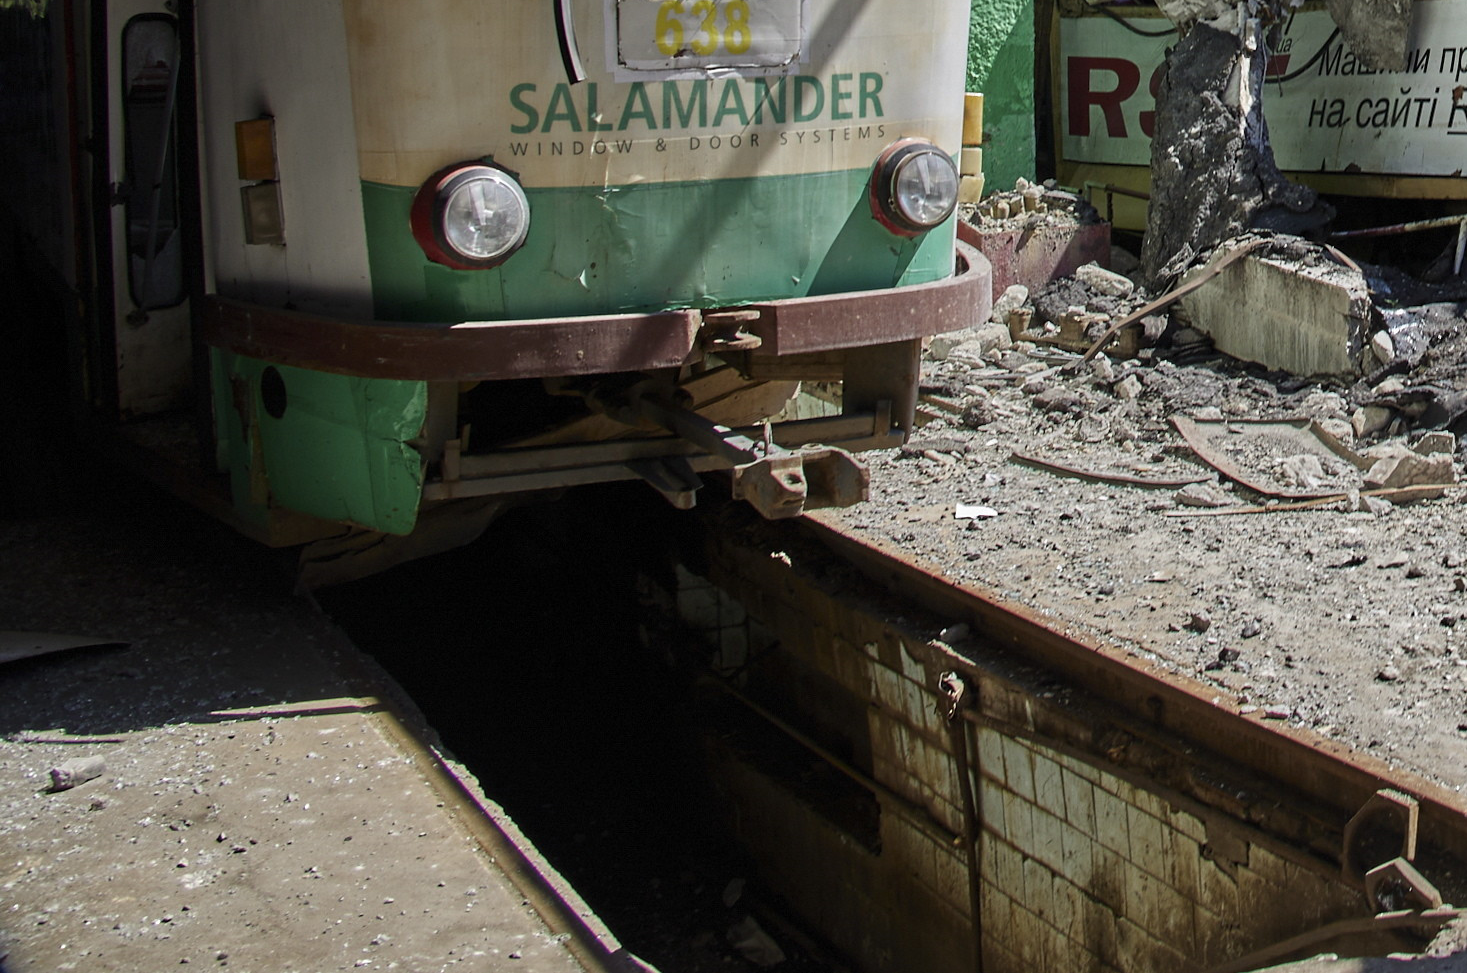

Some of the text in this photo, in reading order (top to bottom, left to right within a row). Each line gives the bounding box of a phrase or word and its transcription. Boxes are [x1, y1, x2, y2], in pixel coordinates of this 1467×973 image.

[509, 71, 885, 134] SALAMANDER
[1309, 98, 1346, 128] на
[1355, 86, 1440, 129] сайті
[511, 125, 886, 156] WINDOW & DOOR SYSTEMS
